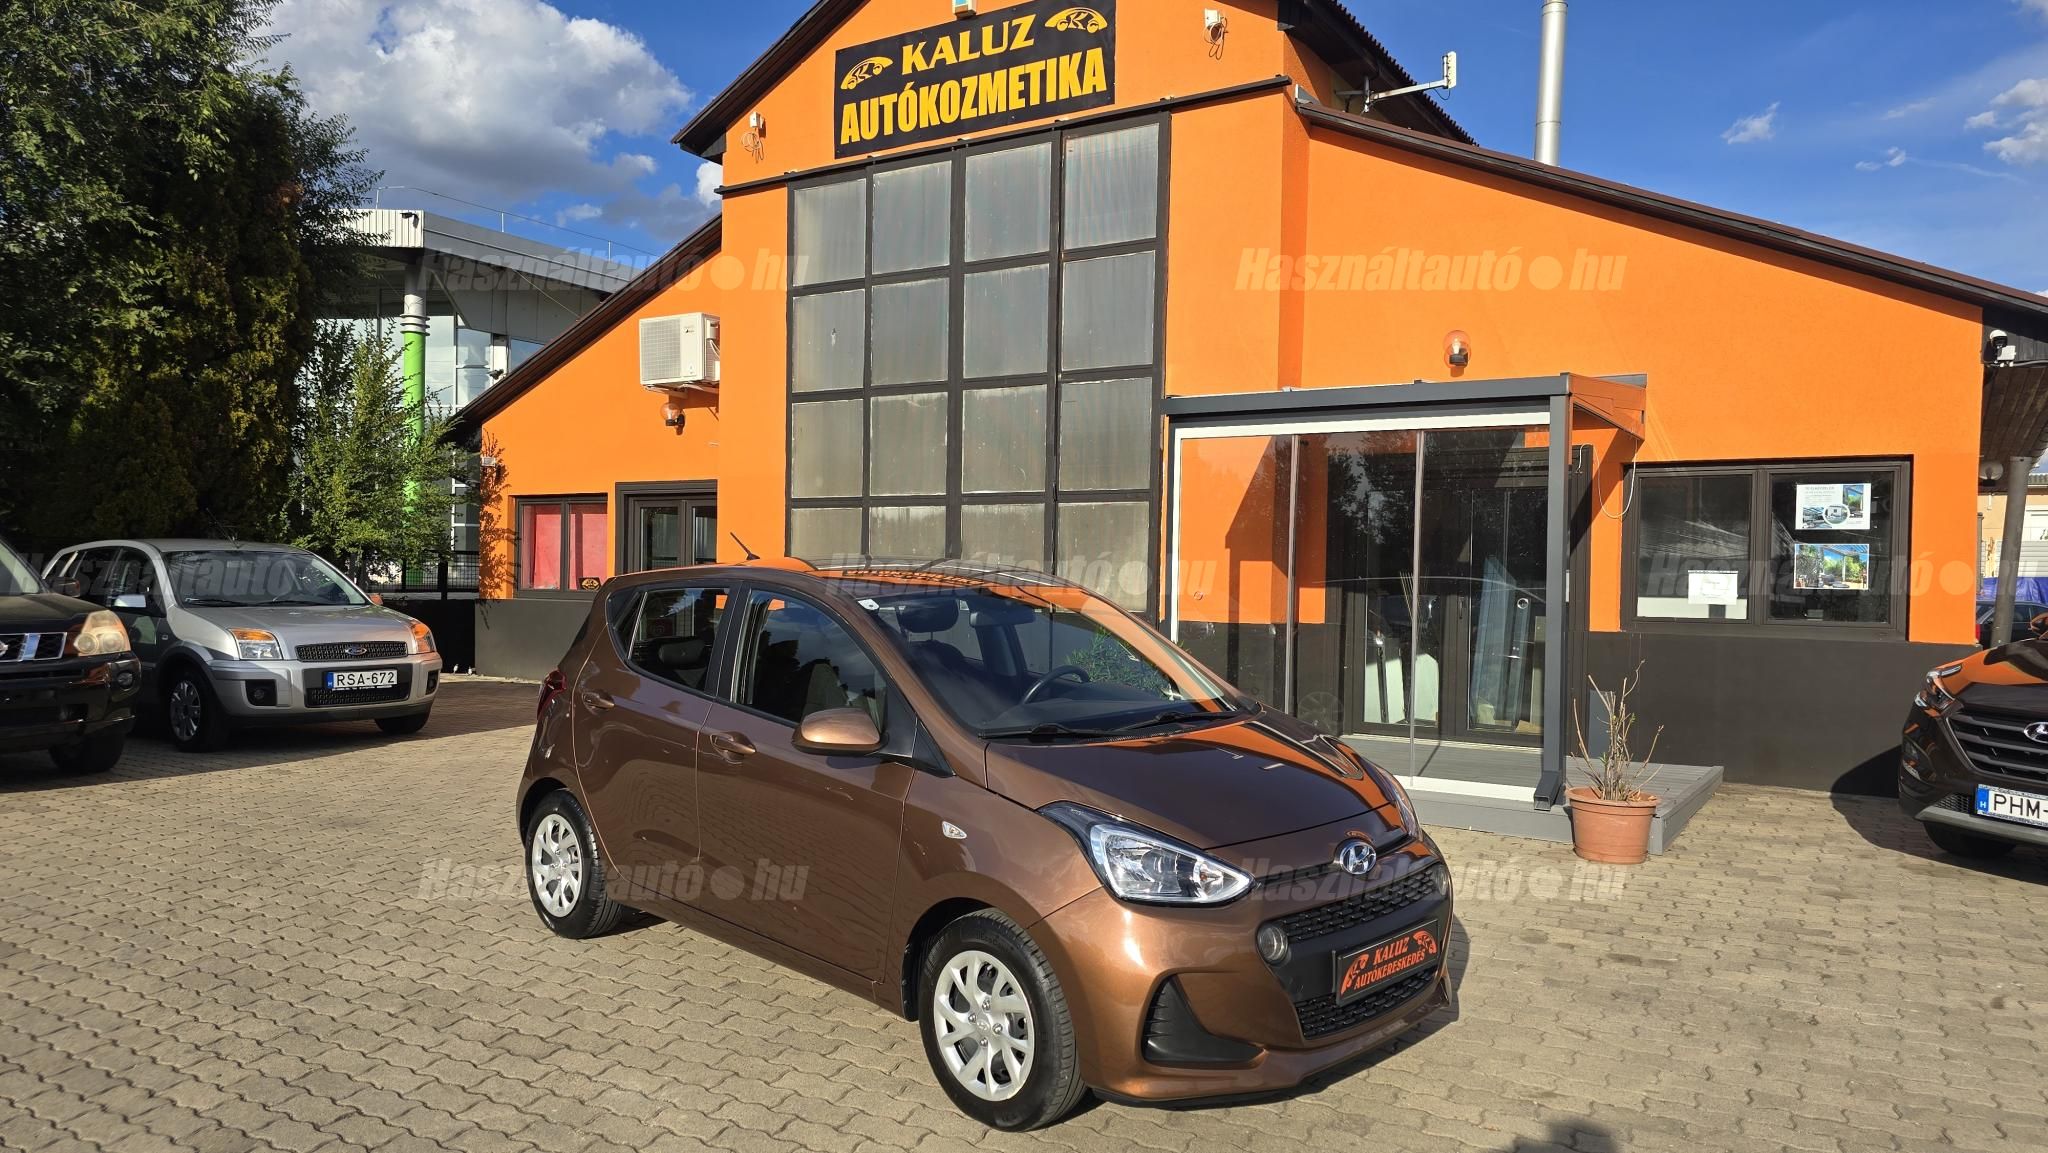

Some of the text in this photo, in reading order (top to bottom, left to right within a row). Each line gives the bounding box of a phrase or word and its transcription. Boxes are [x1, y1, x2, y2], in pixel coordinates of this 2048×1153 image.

[902, 14, 1037, 75] KALUZ
[840, 47, 1108, 145] AUTÓKOZMETIKA
[337, 671, 395, 687] RSA-672
[1373, 936, 1410, 966] KALUZ
